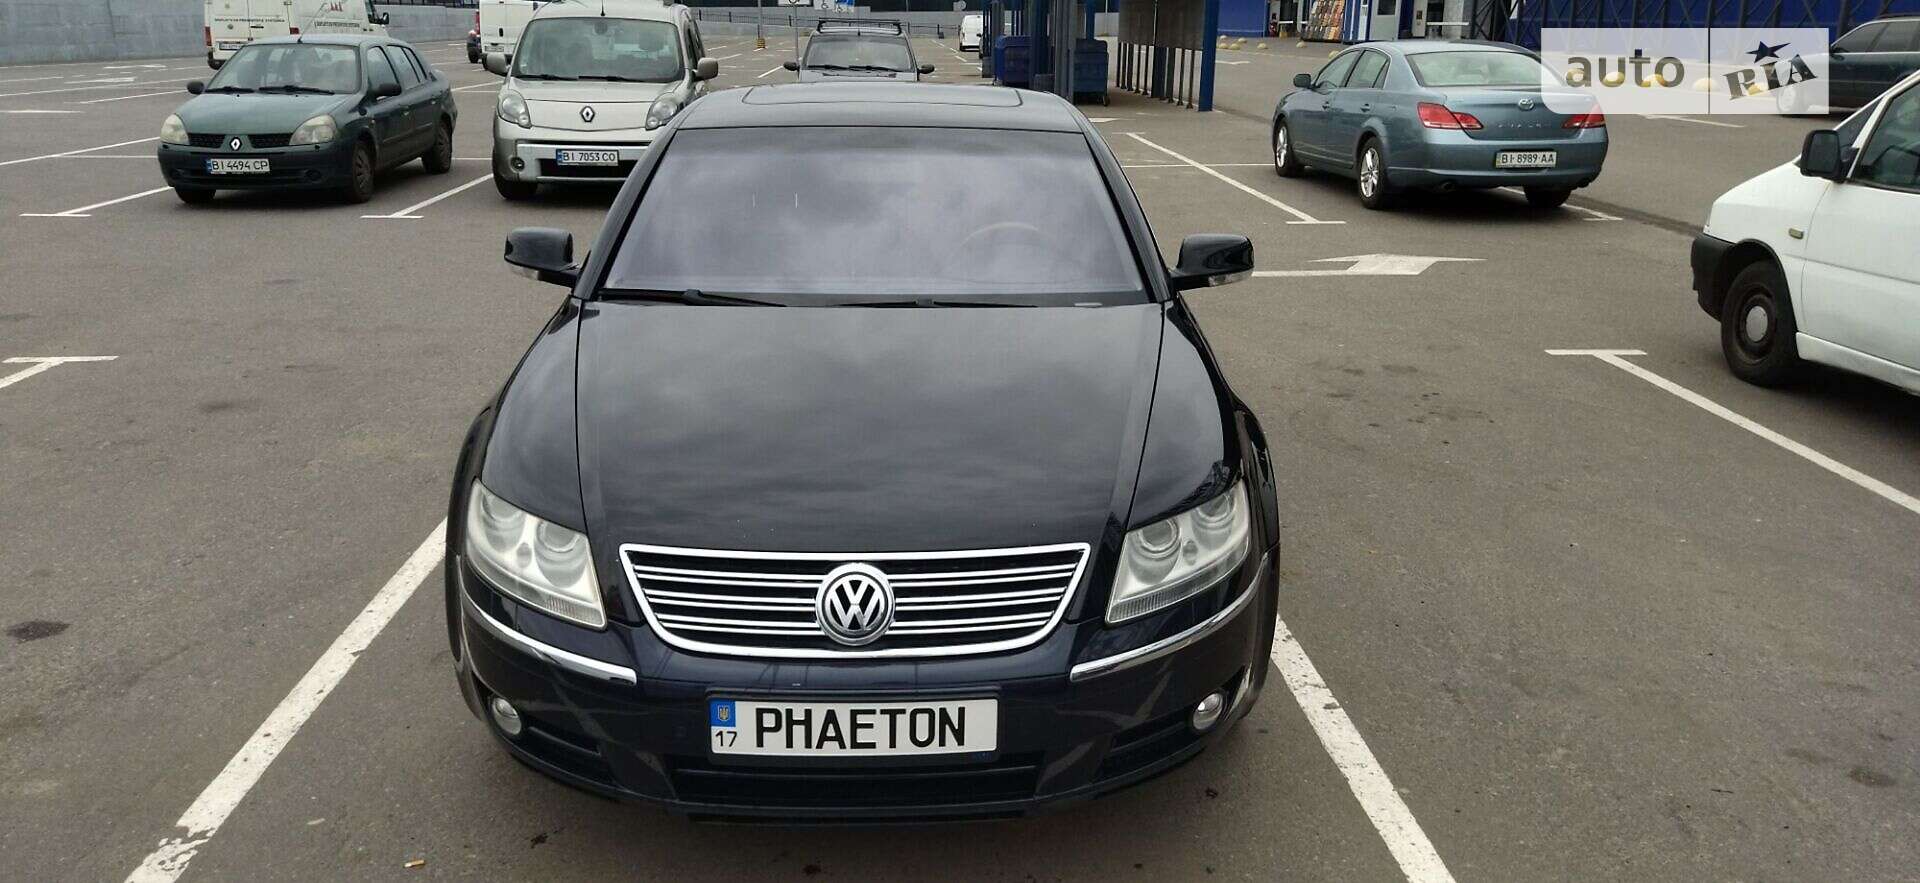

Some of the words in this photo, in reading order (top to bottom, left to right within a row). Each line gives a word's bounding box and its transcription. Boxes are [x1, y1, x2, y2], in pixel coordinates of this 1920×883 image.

[563, 152, 575, 161] BI
[579, 152, 600, 161] 7053
[602, 152, 616, 161] CO
[1517, 154, 1538, 164] 8989
[1540, 154, 1554, 163] AA
[212, 160, 224, 170] BI
[227, 160, 251, 170] 4494
[253, 160, 268, 170] CP
[715, 730, 738, 748] 17
[755, 706, 966, 750] PHAETON
